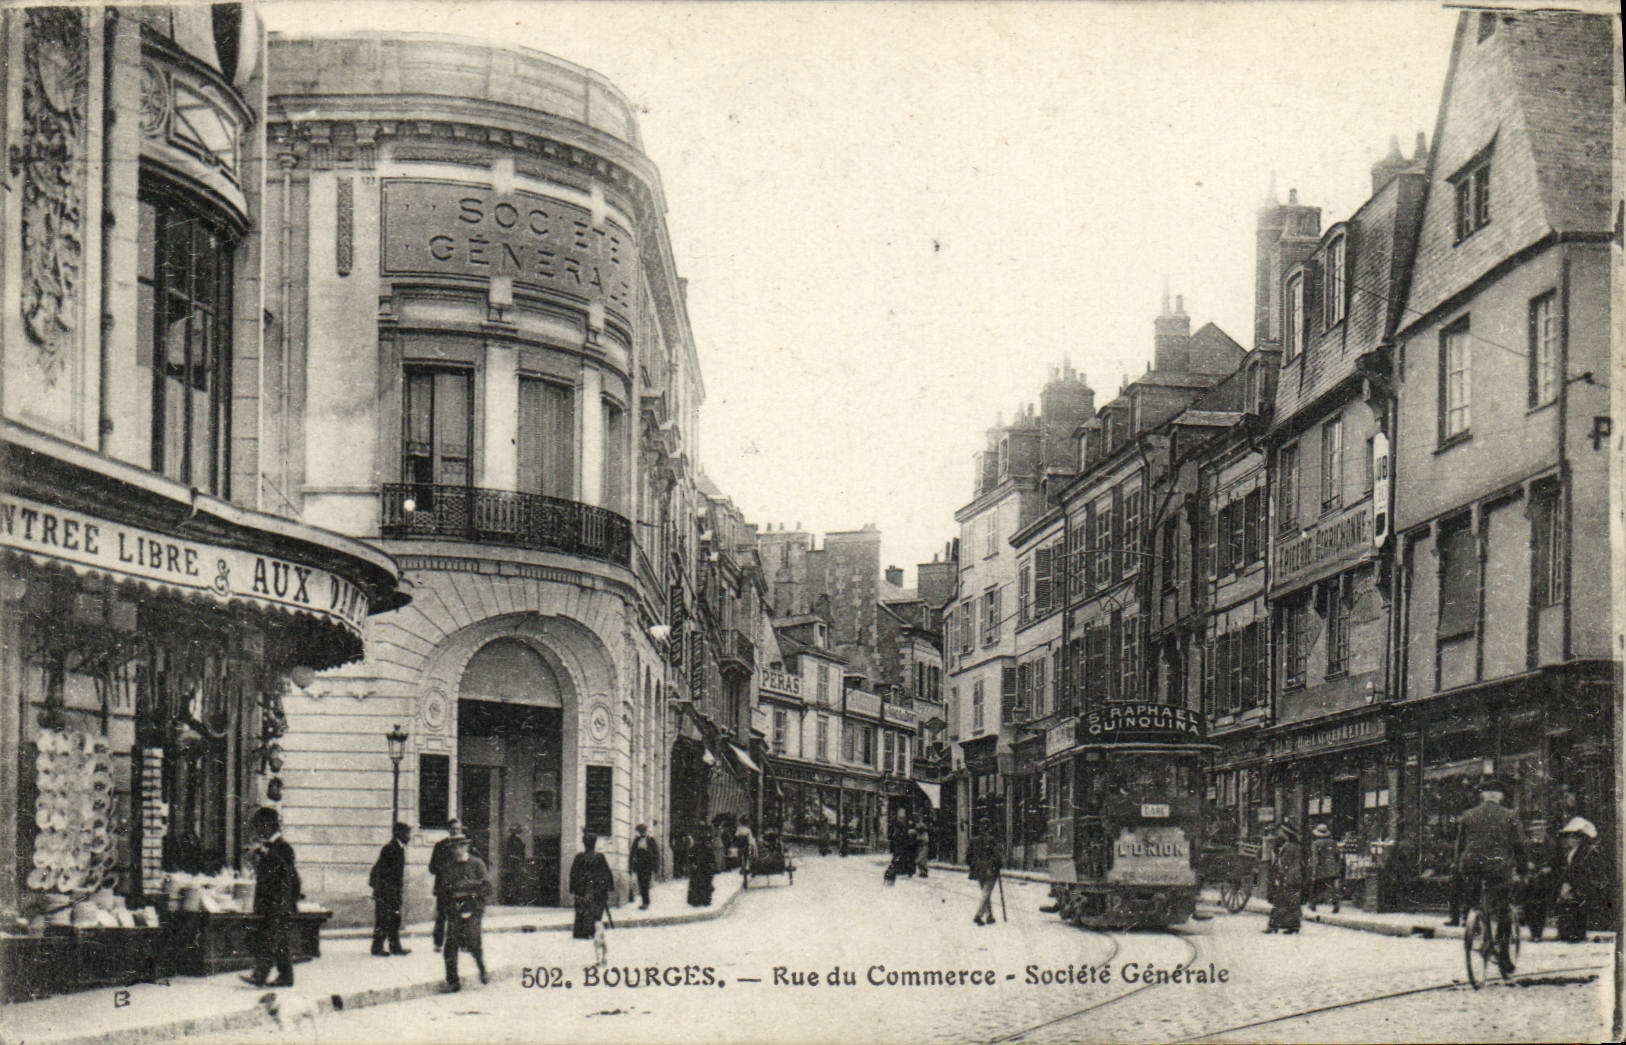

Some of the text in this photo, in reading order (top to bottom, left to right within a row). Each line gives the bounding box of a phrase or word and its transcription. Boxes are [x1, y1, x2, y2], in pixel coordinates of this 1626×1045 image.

[118, 532, 199, 577] LIBRE
[252, 557, 312, 604] AUX
[1110, 705, 1198, 725] RAPHAEL
[1089, 716, 1200, 736] QUINQUINA
